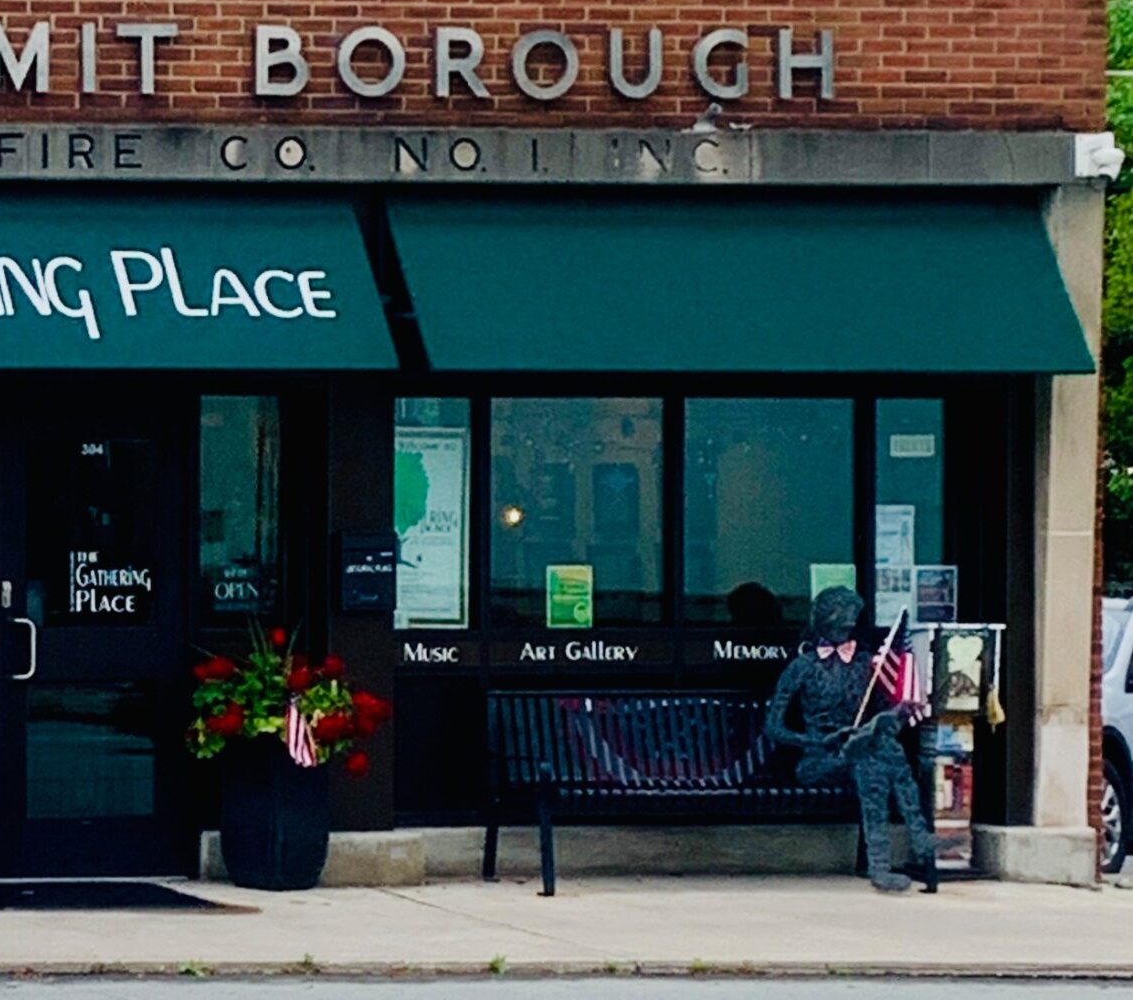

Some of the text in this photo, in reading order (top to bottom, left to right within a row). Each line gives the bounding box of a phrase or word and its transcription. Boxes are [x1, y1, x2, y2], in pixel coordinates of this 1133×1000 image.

[255, 24, 835, 102] BOROUGH
[219, 135, 316, 172] CO.
[394, 136, 487, 173] NO.
[111, 247, 337, 319] PLACE
[75, 588, 136, 613] PLACE
